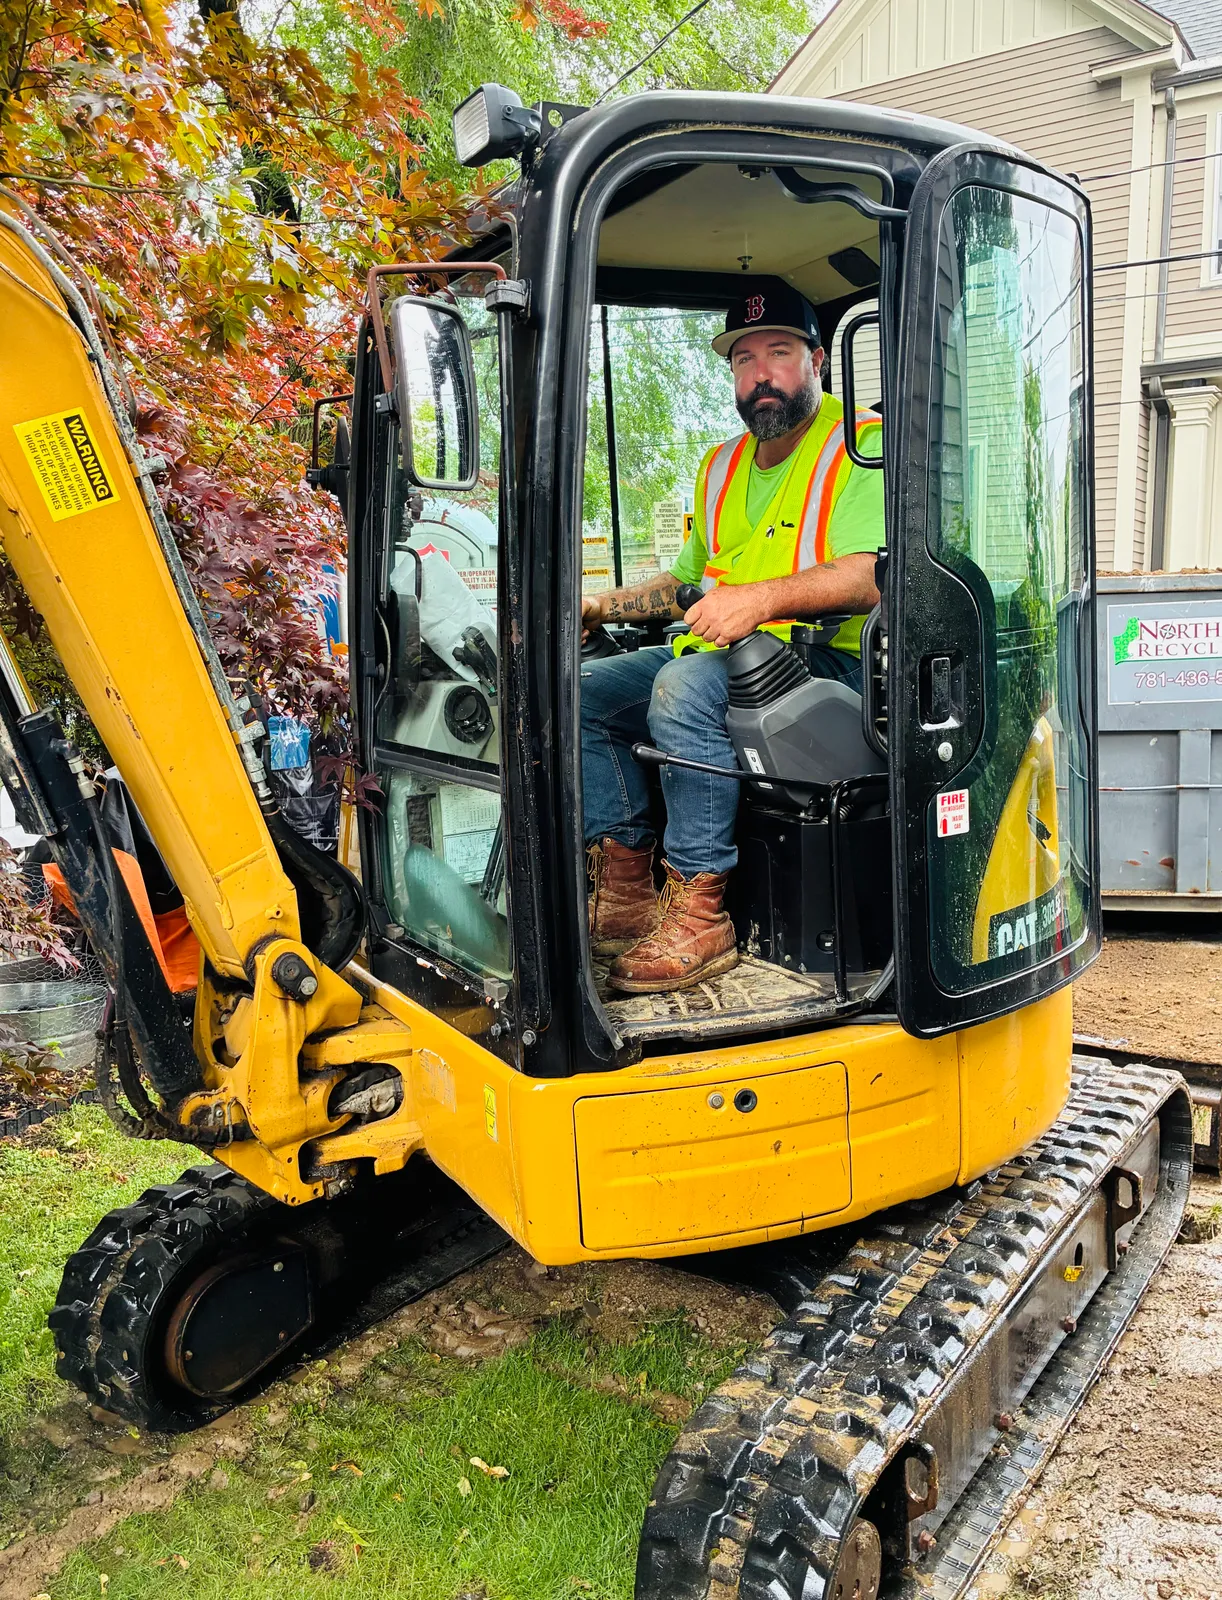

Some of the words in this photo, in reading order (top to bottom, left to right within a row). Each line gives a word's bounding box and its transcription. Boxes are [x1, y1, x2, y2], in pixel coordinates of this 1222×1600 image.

[744, 294, 766, 323] B
[33, 429, 42, 438] 10
[37, 438, 51, 458] FEET
[51, 421, 73, 462] UNLAWFUL
[24, 434, 38, 454] HIGH
[33, 455, 52, 488] VOLTAGE
[47, 488, 62, 510] LINES
[41, 422, 54, 440] THIS
[49, 440, 72, 483] EQUIPMENT
[67, 482, 83, 511] WITHIN
[46, 459, 56, 470] OF
[67, 418, 110, 498] WARNING
[69, 462, 79, 474] TO
[51, 471, 73, 510] OVERHEAD
[73, 473, 93, 506] OPERATE
[1139, 620, 1220, 641] NORTH
[941, 793, 965, 806] FIRE
[997, 911, 1038, 957] CAT
